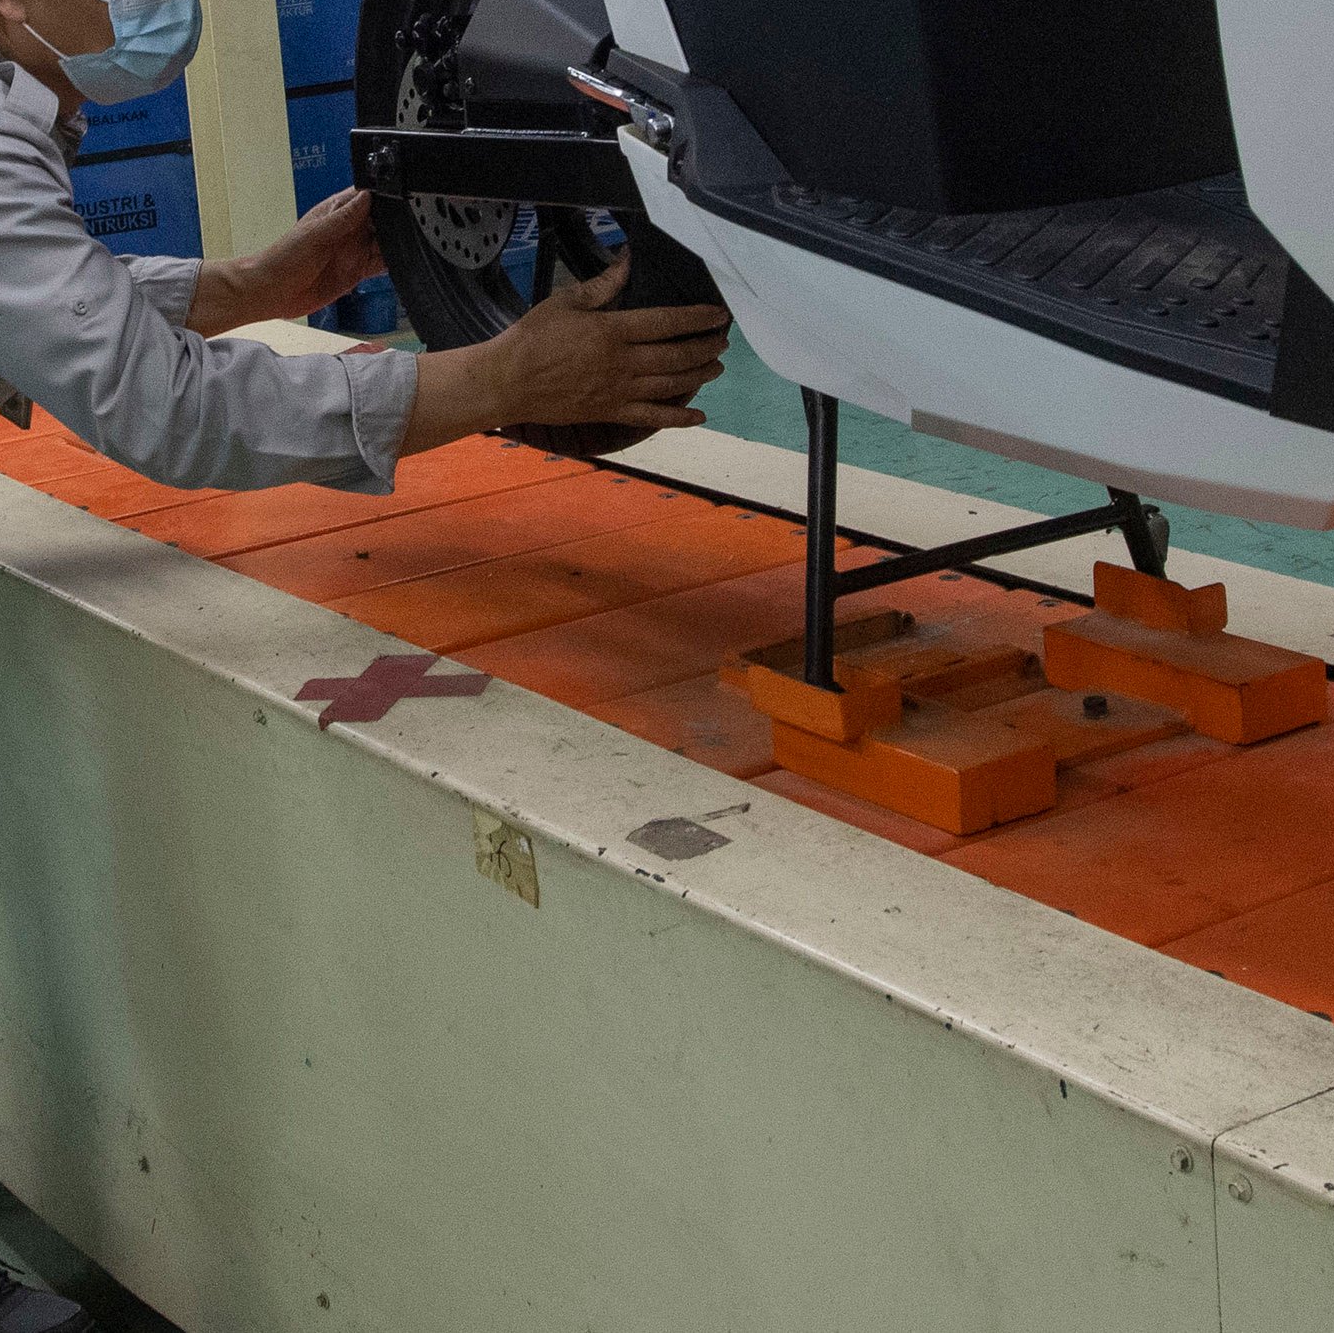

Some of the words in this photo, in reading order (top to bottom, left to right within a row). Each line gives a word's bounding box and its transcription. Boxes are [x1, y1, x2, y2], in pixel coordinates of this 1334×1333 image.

[278, 5, 314, 18] AKTUR
[292, 142, 327, 157] STRI
[74, 195, 138, 217] DUSTRI
[143, 193, 156, 208] &
[84, 211, 156, 235] NTRUKSI
